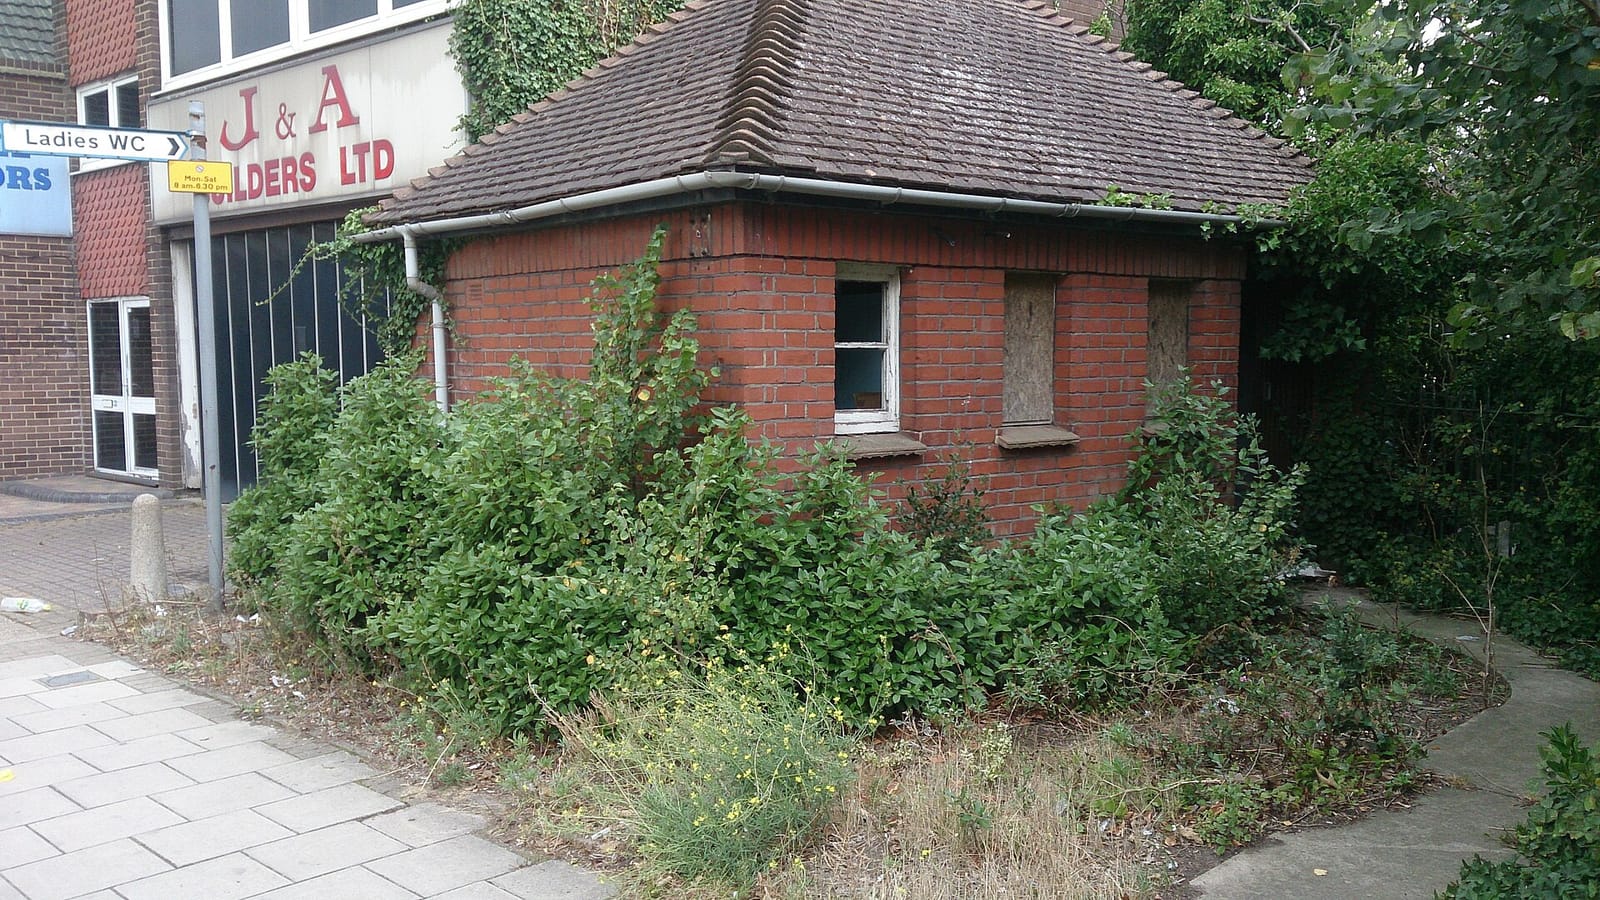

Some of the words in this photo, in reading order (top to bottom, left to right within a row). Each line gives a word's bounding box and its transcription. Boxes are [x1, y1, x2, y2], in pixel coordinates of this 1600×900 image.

[220, 86, 259, 151] J
[275, 102, 296, 140] &
[308, 64, 360, 134] A
[26, 129, 98, 148] Ladies
[108, 134, 145, 152] WC
[0, 165, 52, 191] RS
[211, 152, 317, 205] LDERS
[339, 139, 395, 186] LTD
